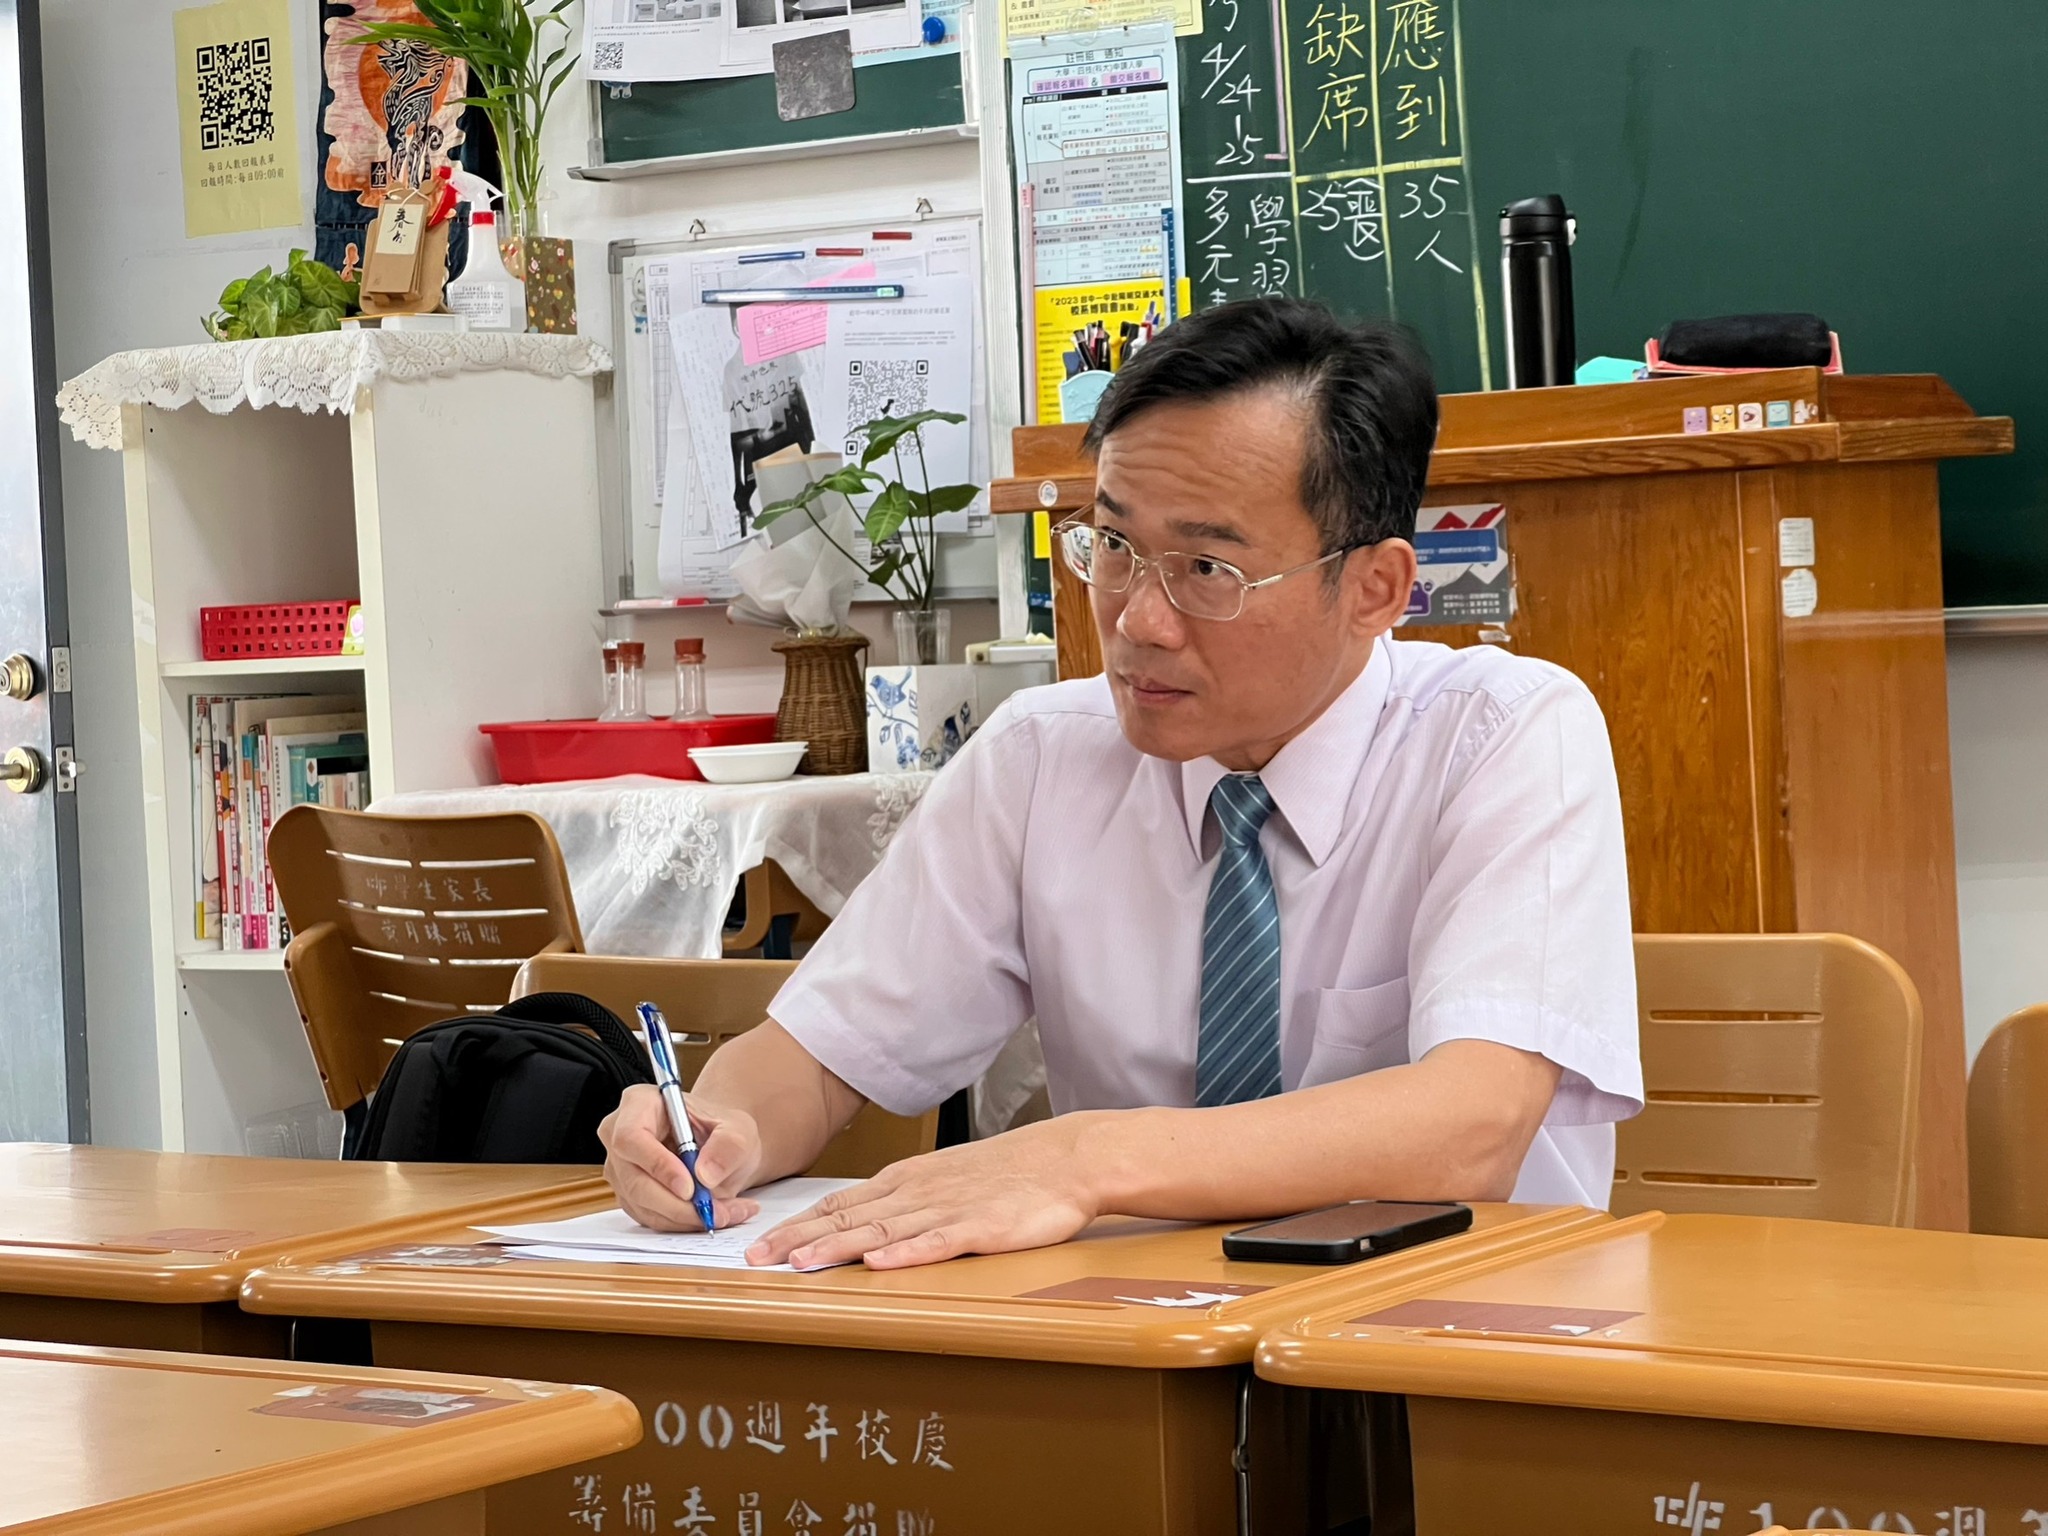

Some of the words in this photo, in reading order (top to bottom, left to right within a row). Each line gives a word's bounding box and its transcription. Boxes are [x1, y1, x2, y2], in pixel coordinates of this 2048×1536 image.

[1300, 3, 1368, 152] 缺席
[1380, 0, 1446, 147] 應到
[1400, 173, 1460, 219] 35
